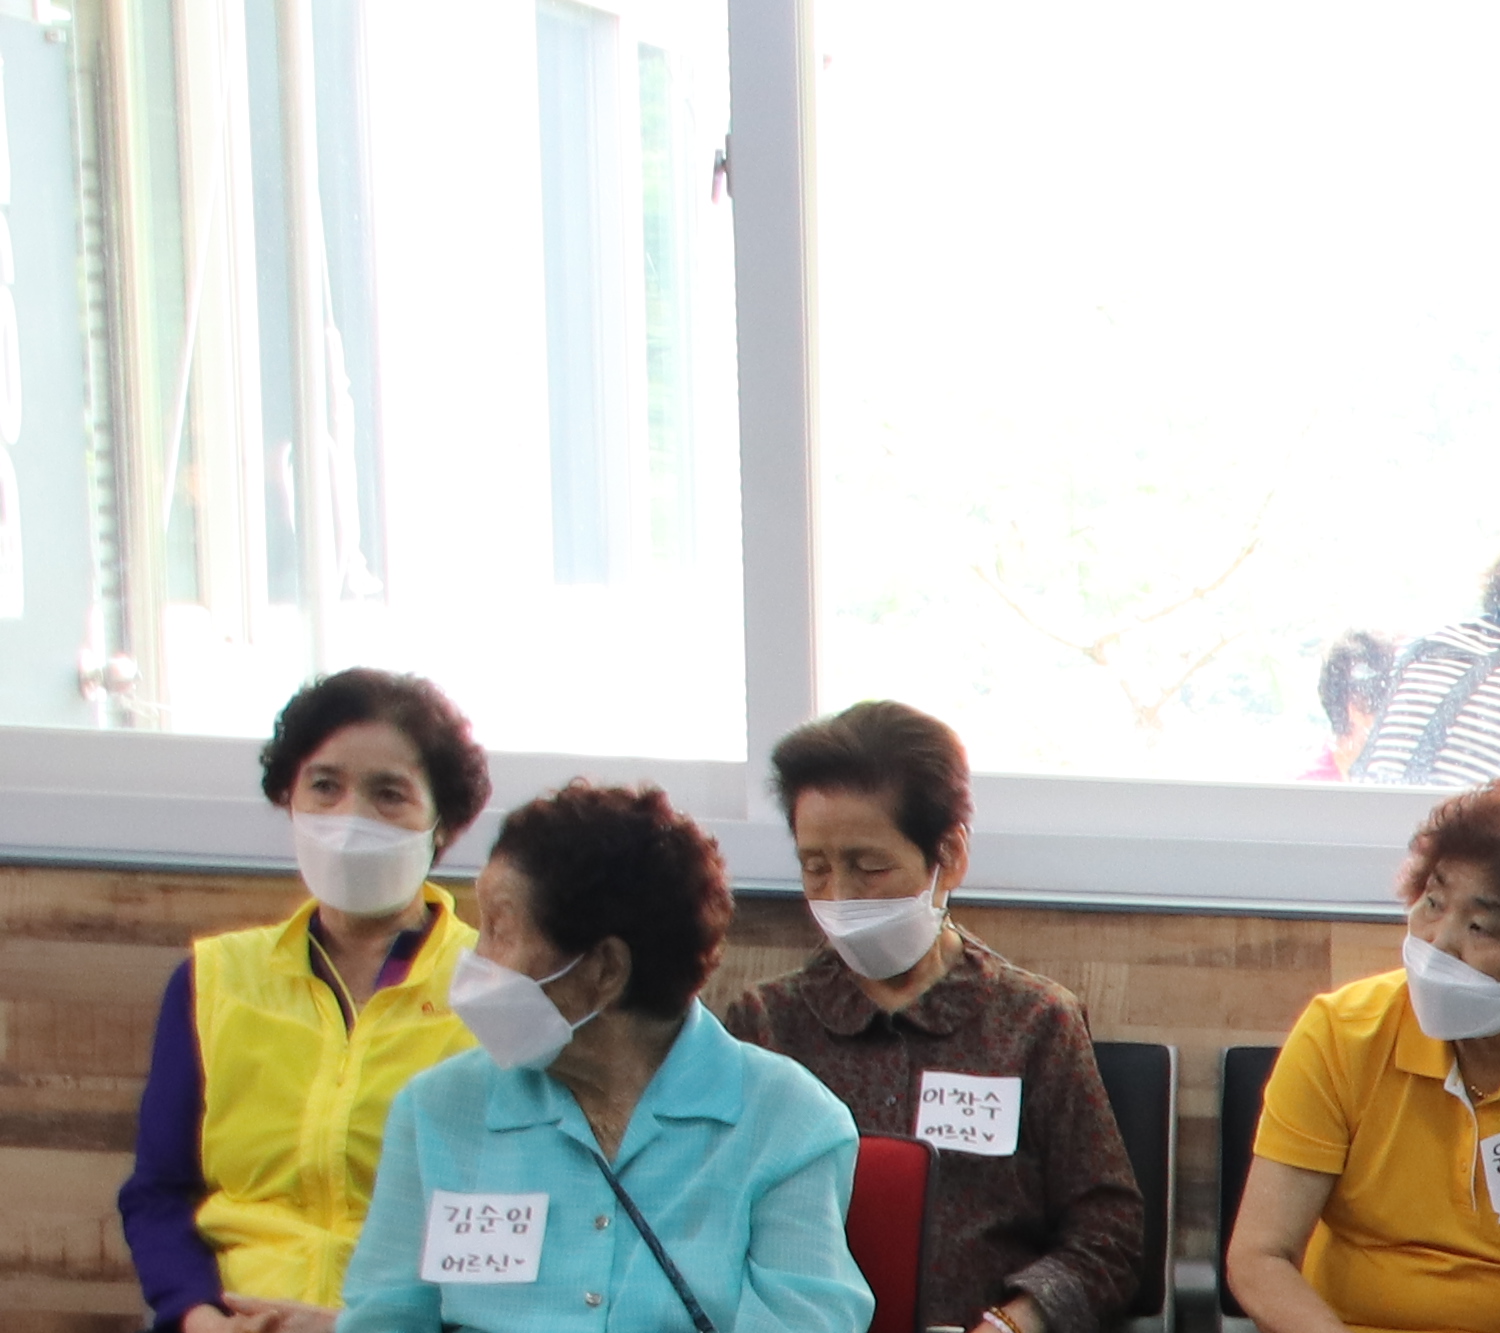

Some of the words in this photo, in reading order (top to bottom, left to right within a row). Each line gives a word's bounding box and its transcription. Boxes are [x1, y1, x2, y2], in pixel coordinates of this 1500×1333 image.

[924, 1124, 977, 1144] 어르신
[443, 1204, 532, 1234] 김순임
[441, 1254, 509, 1273] 어르신
